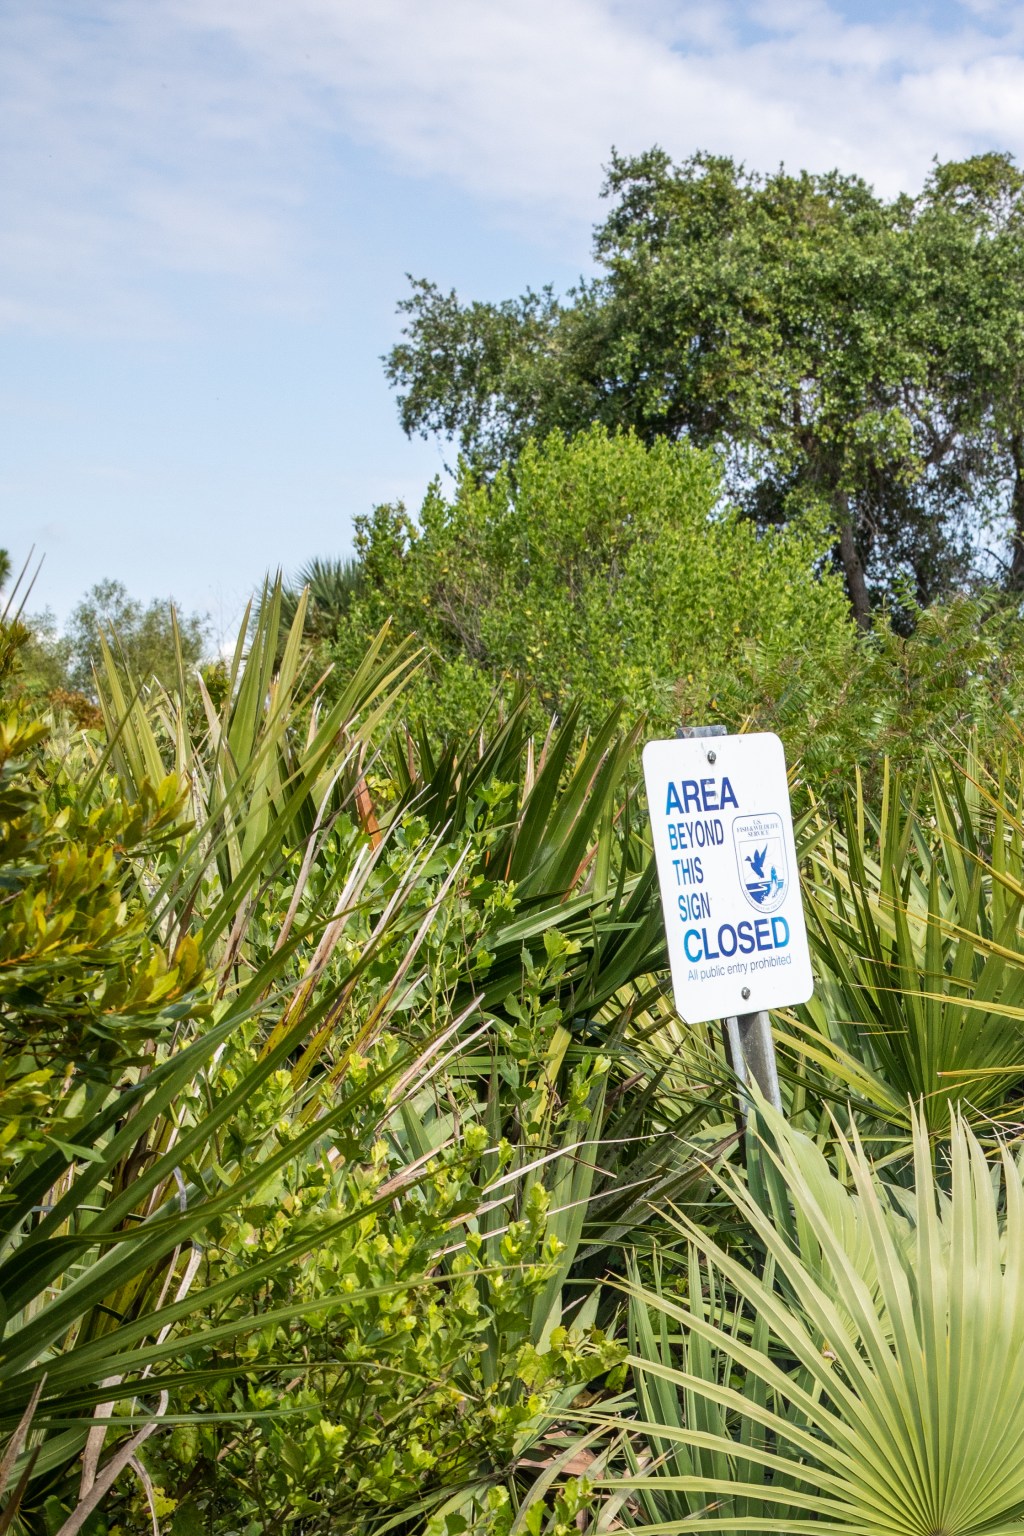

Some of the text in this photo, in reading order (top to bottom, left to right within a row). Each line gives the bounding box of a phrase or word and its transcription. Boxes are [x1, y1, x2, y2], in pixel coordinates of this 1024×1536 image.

[665, 776, 739, 815] AREA
[667, 818, 724, 851] BEYOND
[672, 856, 704, 886] THIS
[678, 891, 711, 922] SIGN
[683, 916, 790, 963] CLOSED
[687, 953, 792, 982] All public entry prohibited
